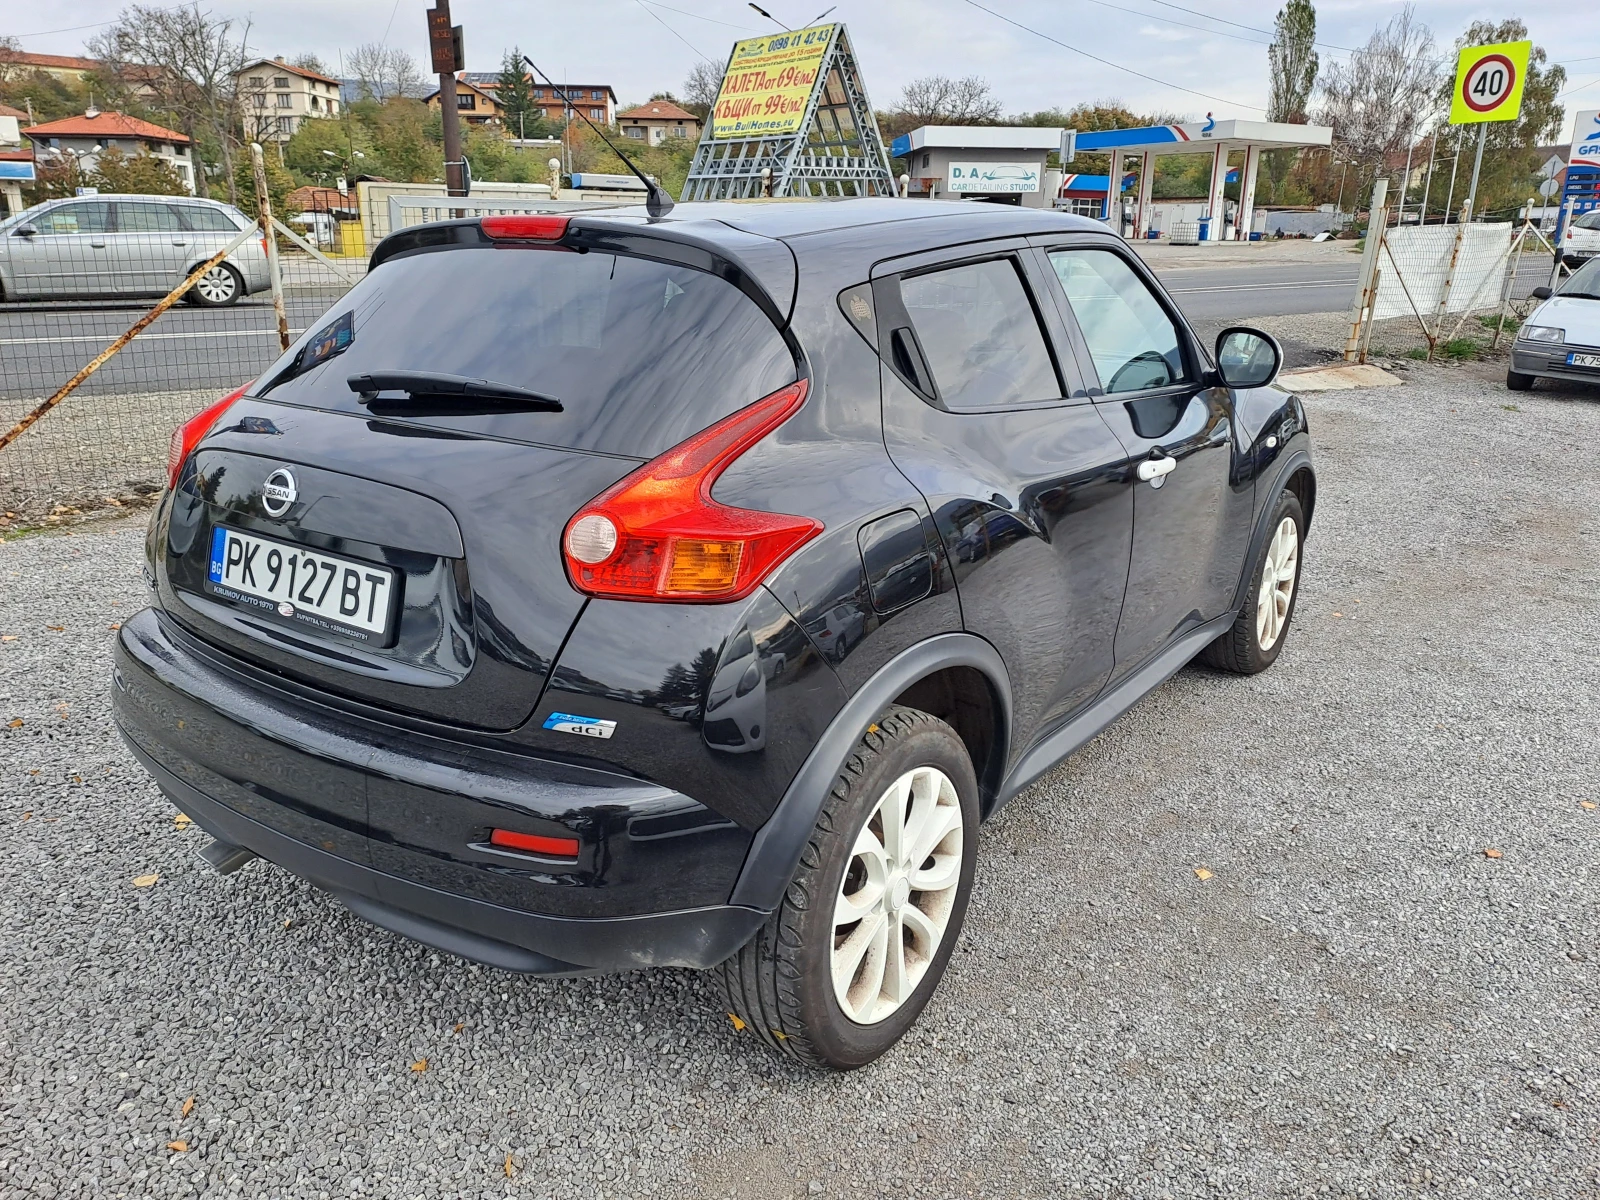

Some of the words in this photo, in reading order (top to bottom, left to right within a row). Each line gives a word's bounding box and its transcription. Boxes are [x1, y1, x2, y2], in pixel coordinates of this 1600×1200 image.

[768, 36, 790, 52] 0898
[790, 34, 802, 47] 41
[804, 32, 816, 45] 42
[816, 29, 830, 42] 43
[722, 71, 766, 94] ХАЛЕТА
[1473, 70, 1503, 96] 40
[714, 98, 754, 120] КЪЩИ
[1579, 145, 1600, 155] GA
[953, 168, 965, 178] D.
[970, 168, 979, 178] A
[1574, 355, 1588, 364] PK
[212, 560, 222, 575] BG
[226, 537, 260, 588] PK
[267, 549, 337, 607] 9127
[339, 568, 385, 623] BT
[213, 586, 240, 600] KRUMOV
[240, 595, 258, 605] AUTO
[259, 600, 273, 610] 1970
